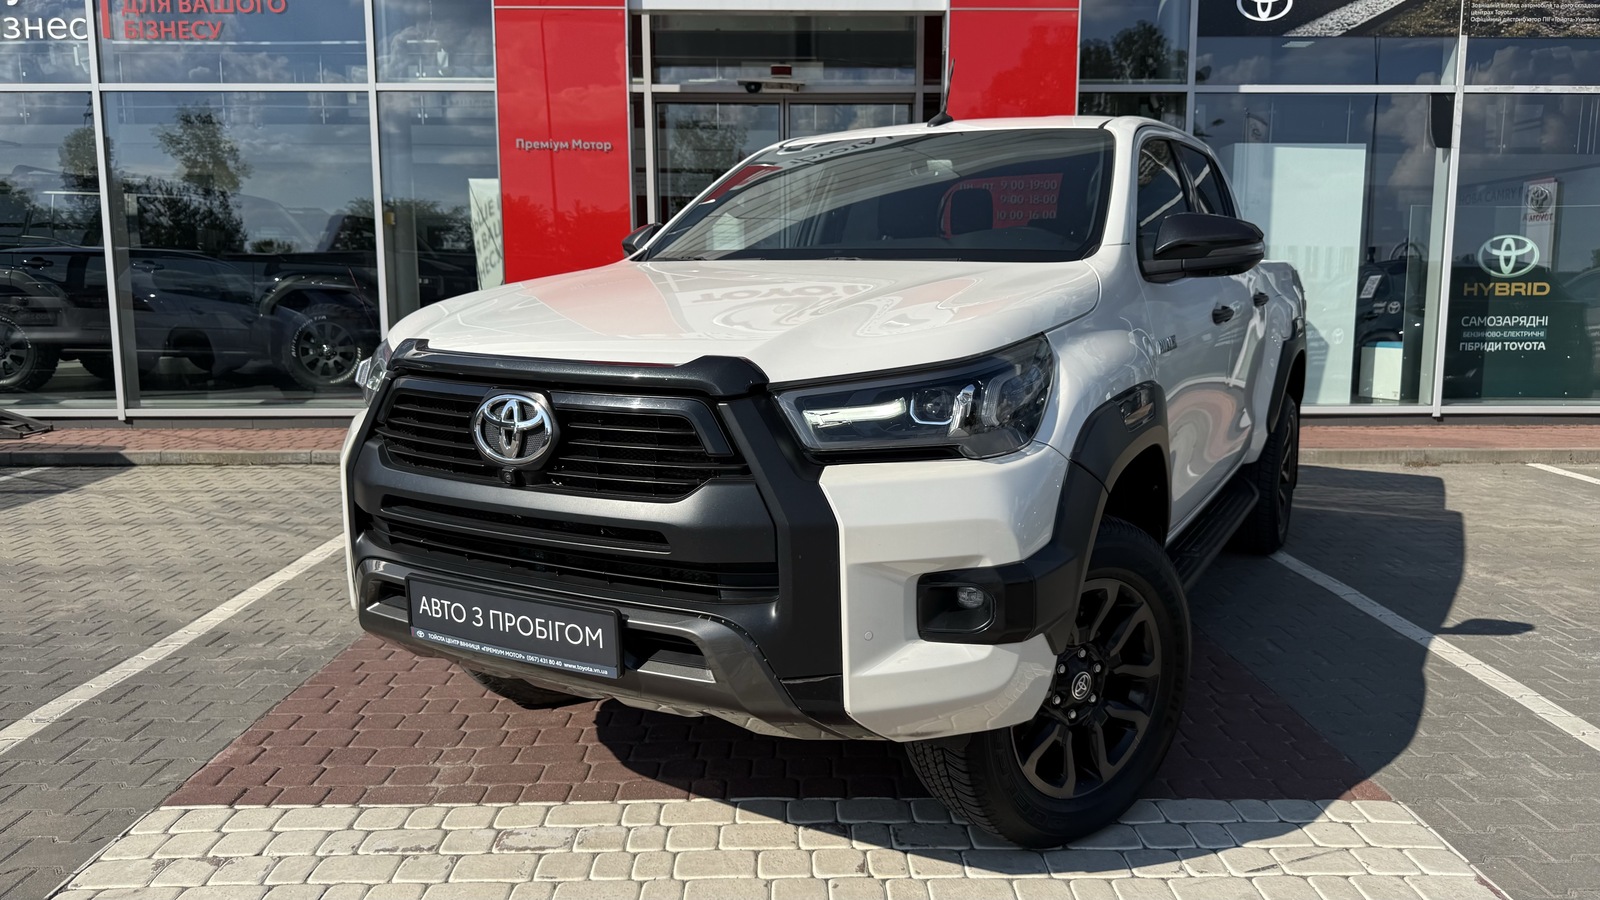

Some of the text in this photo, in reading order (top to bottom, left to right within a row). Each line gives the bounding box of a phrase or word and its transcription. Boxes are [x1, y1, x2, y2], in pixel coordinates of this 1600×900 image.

[122, 0, 286, 17] ДЛЯ ВАШОГО
[124, 20, 222, 39] БІЗНЕСУ
[515, 138, 612, 152] Преміум Мотор
[1463, 282, 1551, 296] HYBRID
[1461, 315, 1549, 327] САМОЗАРЯДНІ
[1459, 341, 1546, 352] ГІБРИДИ TOYOTA
[419, 595, 467, 623] АВТО
[489, 609, 604, 649] ПРОБІГОМ
[427, 632, 446, 642] ТОЙОТА
[526, 655, 540, 664] (067)
[563, 663, 608, 675] www.toyota.vn.ua
